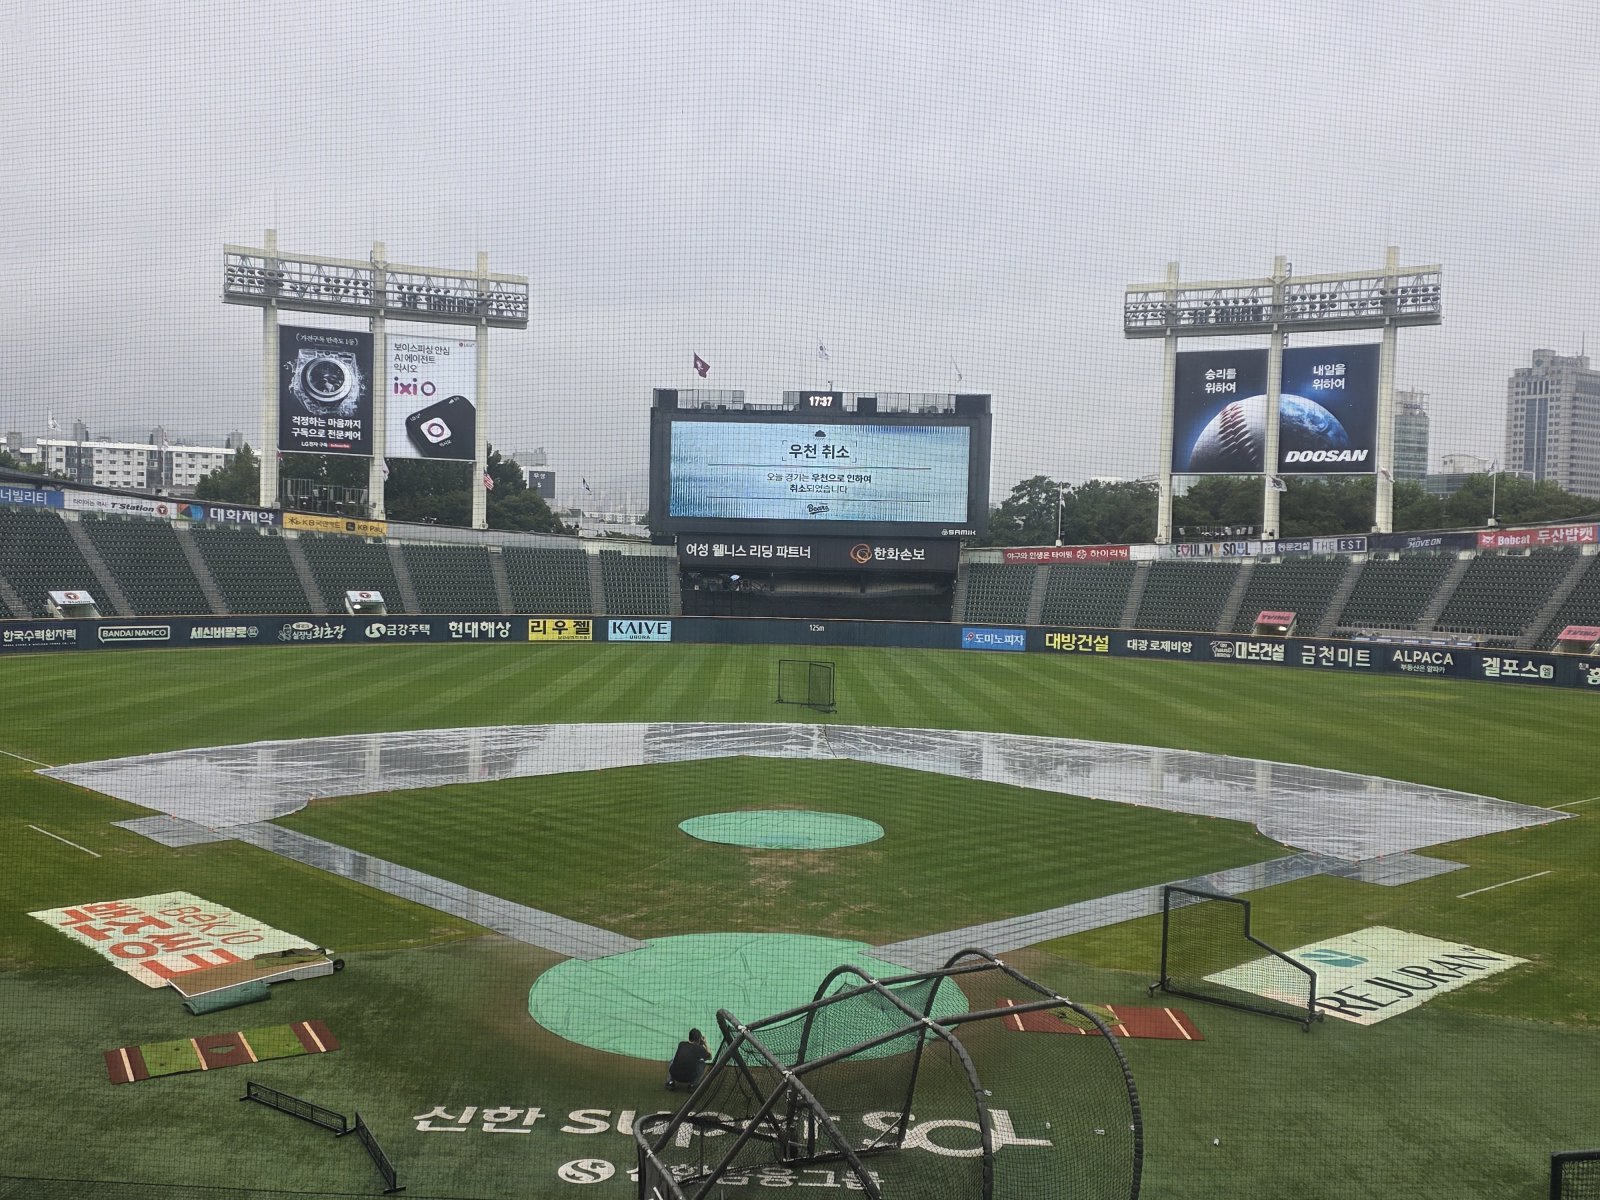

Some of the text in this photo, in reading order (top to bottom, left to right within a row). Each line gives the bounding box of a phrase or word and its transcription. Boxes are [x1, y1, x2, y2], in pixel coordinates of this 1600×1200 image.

[394, 343, 450, 355] 보이스피싱 안심
[394, 353, 436, 364] AI 에이전트
[1205, 368, 1236, 380] 승리를
[1313, 364, 1346, 376] 내일을
[1205, 382, 1236, 393] 위하여
[1312, 378, 1345, 390] 위하여
[809, 396, 833, 407] 17:37
[292, 416, 361, 429] 걱정하는 마음까지
[291, 427, 361, 440] 구독으로 전문케어
[789, 444, 850, 459] 우천 취소
[1285, 449, 1368, 463] DOOSAN
[767, 472, 872, 483] 오늘 경기는 우천으로 인하여
[790, 484, 848, 494] 취소되었습니다
[0, 488, 47, 505] 너빌리티
[210, 507, 275, 525] 대화제약
[1498, 527, 1593, 546] Bobcat 두산밥캣
[686, 543, 811, 559] 여성 웰니스 리딩 파트너
[1314, 540, 1362, 550] THE EST
[874, 546, 926, 560] 한화손보
[1007, 550, 1072, 560] 야구와 인생은 타이밍
[1090, 549, 1128, 558] 하이리빙
[3, 628, 77, 642] 한국수력원자력
[102, 628, 166, 638] BANDAI NAMCO
[190, 626, 247, 639] 세신버팔로
[387, 624, 430, 636] 금강주택
[448, 621, 512, 638] 현대해상
[612, 622, 668, 635] KAIVE
[975, 633, 1025, 646] 도미노피자
[1045, 633, 1109, 653] 대방건설
[1127, 639, 1193, 654] 대광 로제비앙
[1235, 641, 1285, 662] 대보건설
[1301, 645, 1371, 667] 금천미트
[1392, 650, 1454, 666] ALPACA
[1400, 663, 1445, 673] 부동산은 알파카
[1307, 951, 1506, 1017] REJURAN
[413, 1105, 545, 1134] 신한
